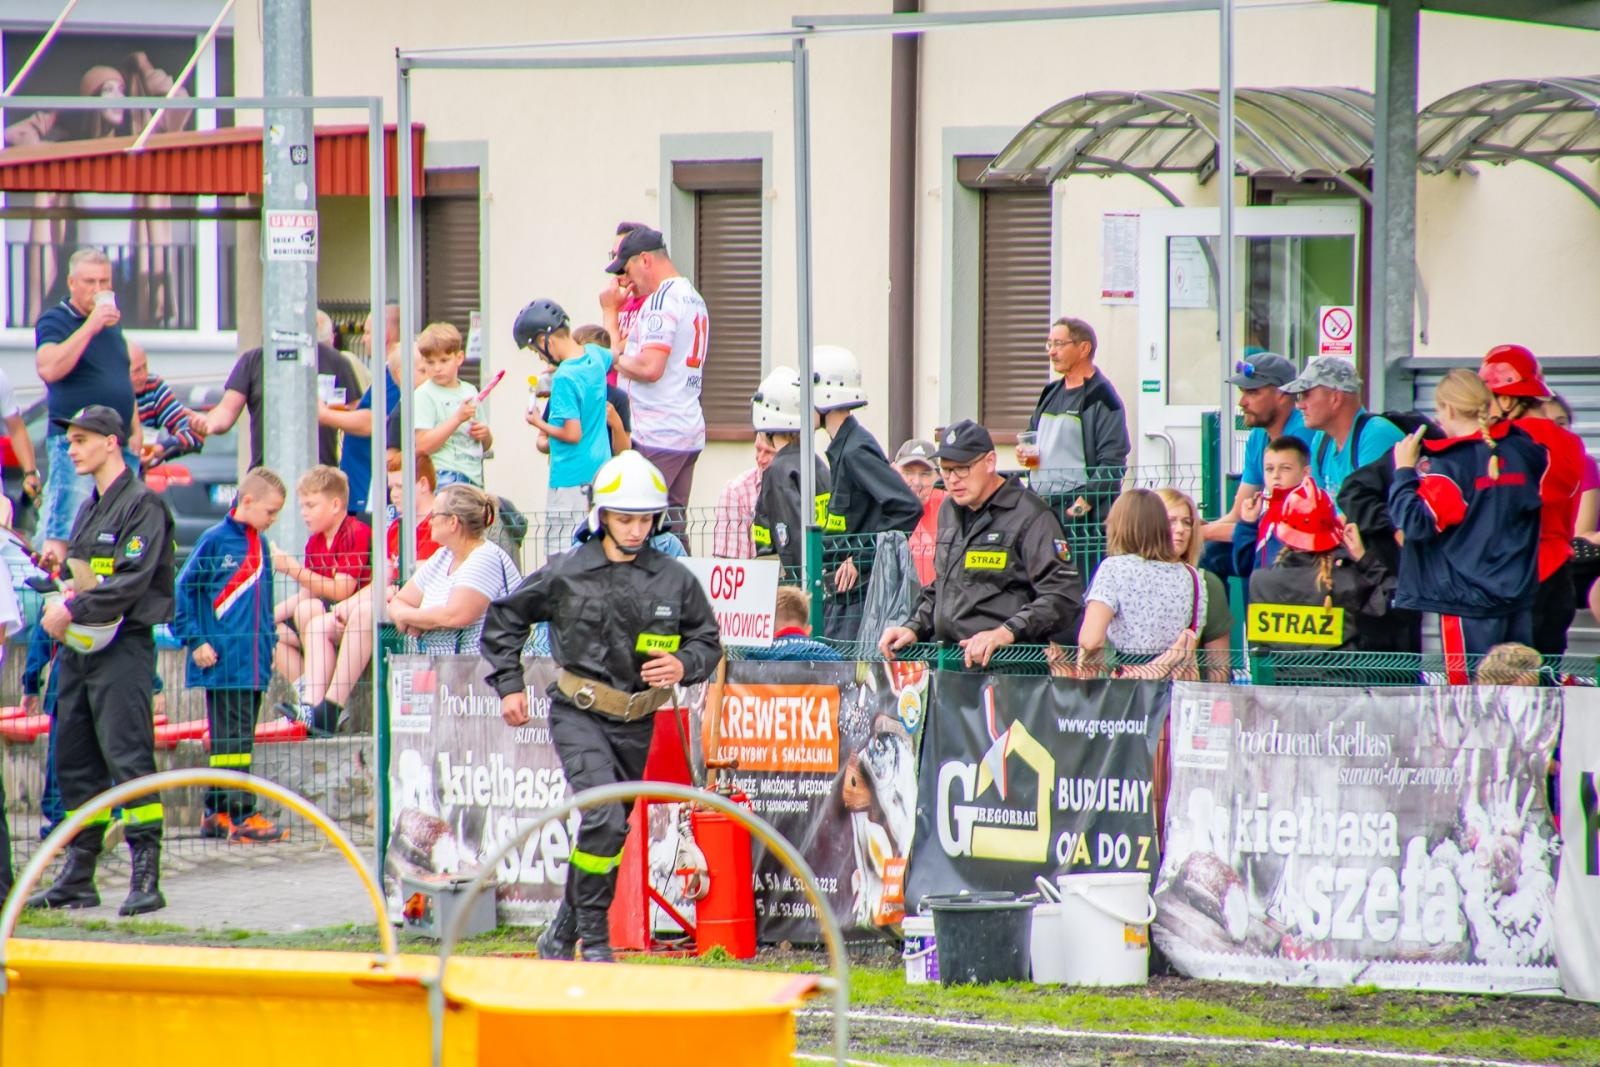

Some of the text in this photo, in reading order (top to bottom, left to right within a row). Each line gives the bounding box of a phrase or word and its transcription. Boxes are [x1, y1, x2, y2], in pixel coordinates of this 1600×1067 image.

[710, 565, 745, 600] OSP
[716, 611, 771, 639] ANOWICE
[440, 683, 501, 717] Producen
[719, 695, 833, 740] KREWETKA
[717, 746, 739, 760] KLEP
[1097, 832, 1132, 868] DO
[1136, 835, 1152, 869] Z
